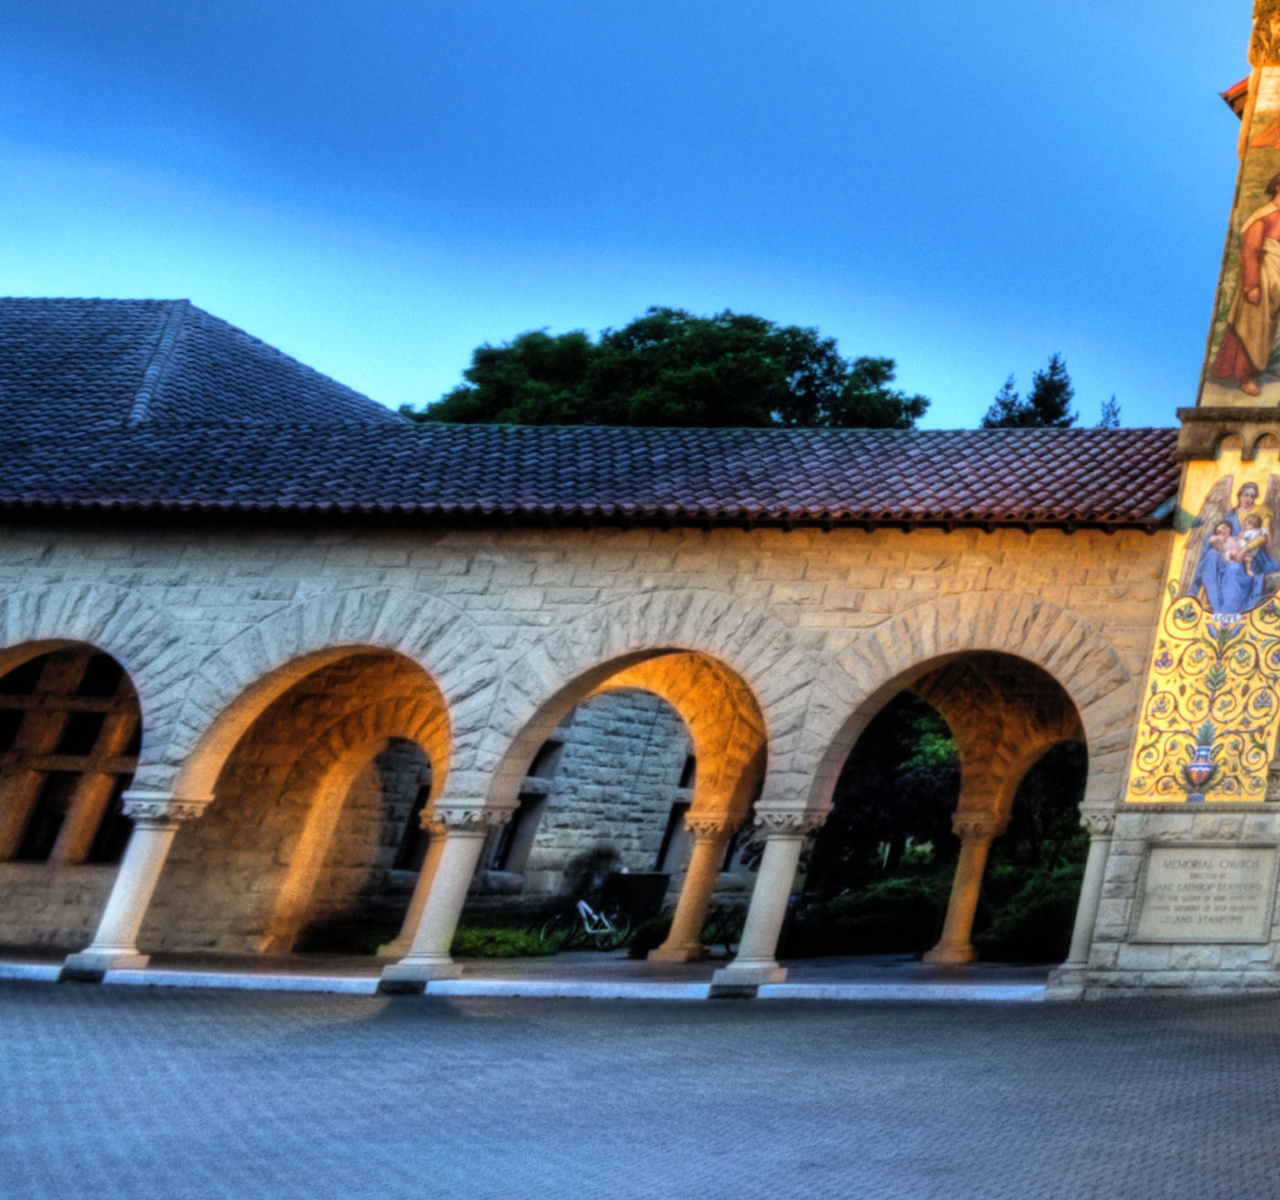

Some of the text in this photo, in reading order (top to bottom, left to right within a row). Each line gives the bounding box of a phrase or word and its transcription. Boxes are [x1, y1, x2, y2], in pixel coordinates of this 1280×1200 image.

[1214, 613, 1239, 622] LOVE
[1162, 859, 1260, 870] MEMORIAL CHURCH
[1198, 915, 1244, 924] STANFORD
